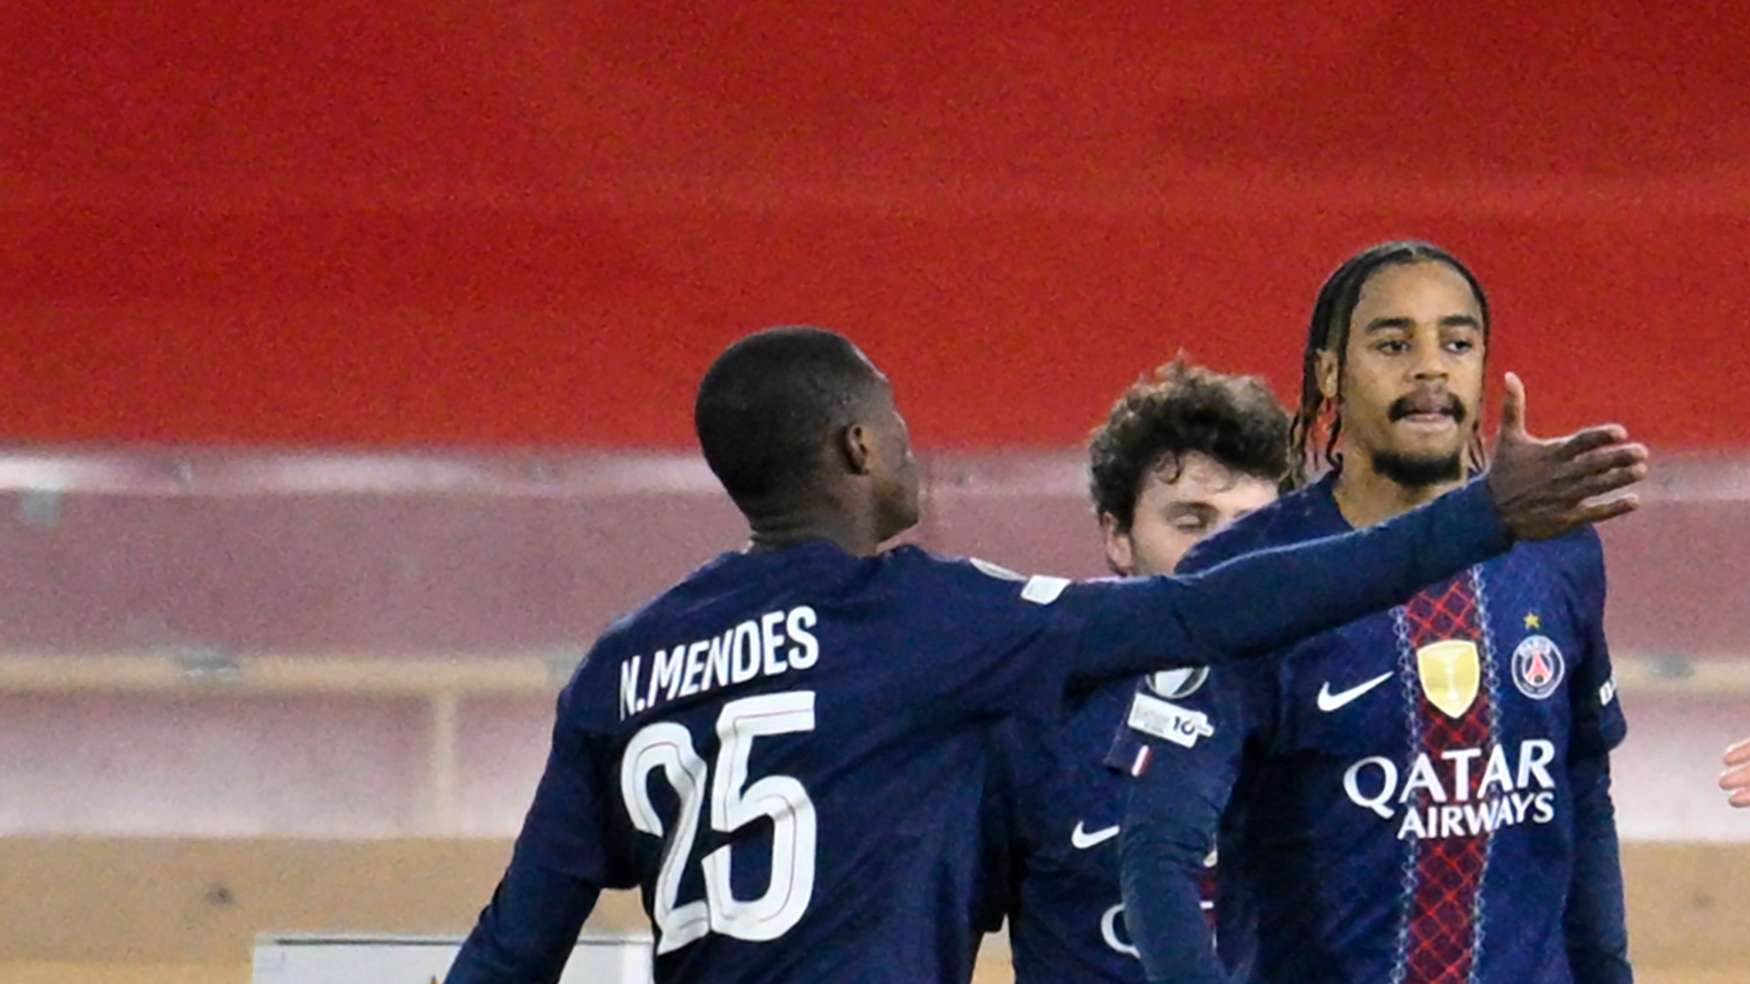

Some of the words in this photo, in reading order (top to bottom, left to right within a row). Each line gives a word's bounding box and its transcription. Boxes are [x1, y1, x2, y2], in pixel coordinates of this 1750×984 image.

[620, 605, 819, 719] N.MENDES
[620, 690, 817, 955] 25
[1343, 739, 1555, 819] QATAR
[1397, 791, 1554, 840] AIRWAYS
